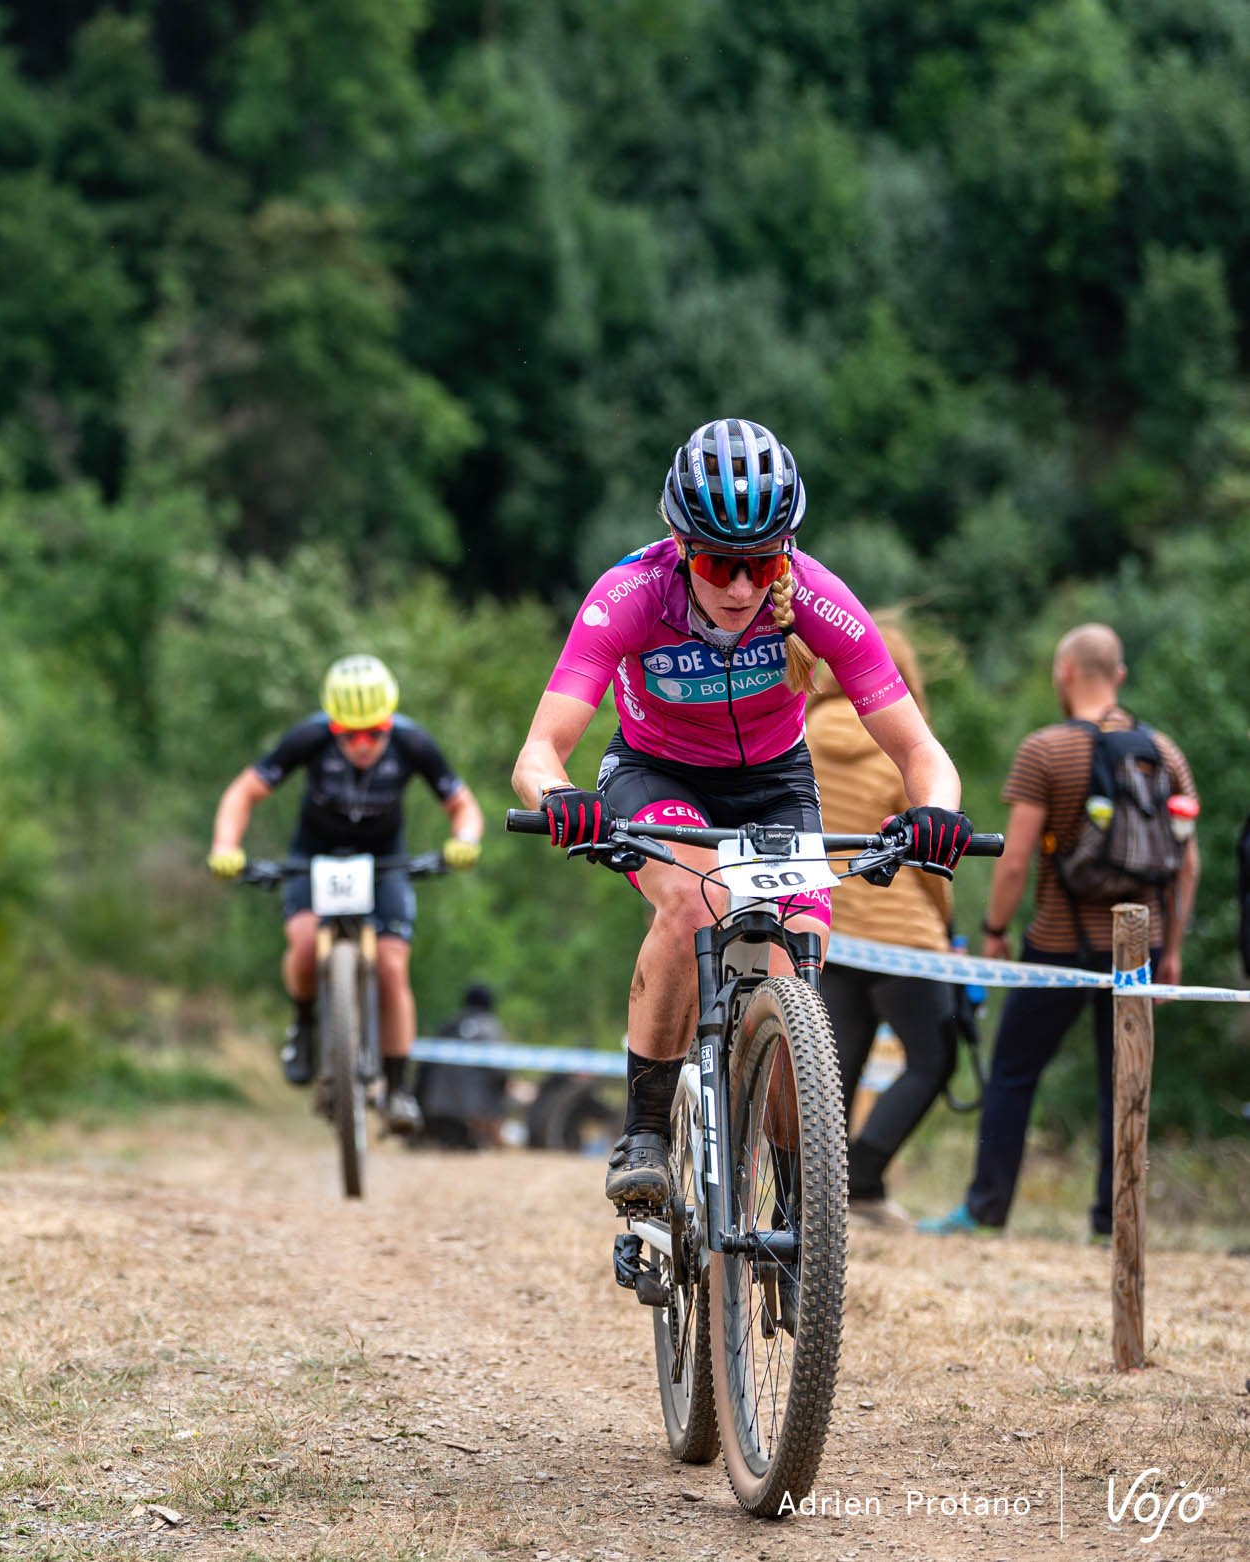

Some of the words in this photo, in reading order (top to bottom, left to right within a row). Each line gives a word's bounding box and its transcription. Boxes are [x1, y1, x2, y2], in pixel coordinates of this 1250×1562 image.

[607, 566, 663, 603] BONACHE
[796, 585, 814, 606] DE
[813, 596, 866, 642] CEUSTER
[677, 651, 704, 673] DE
[710, 642, 787, 668] CEUSTE
[751, 871, 806, 889] 60
